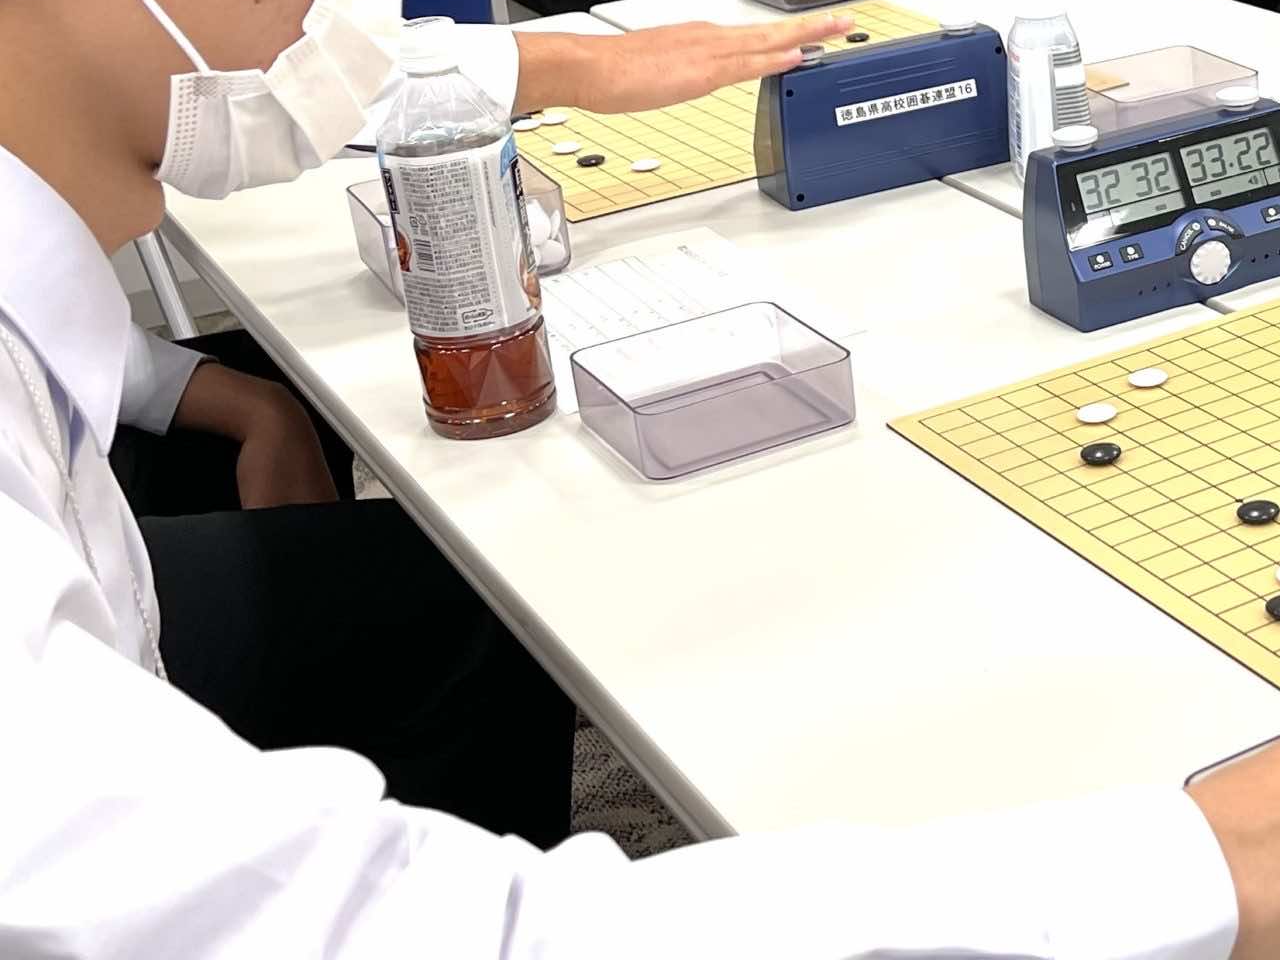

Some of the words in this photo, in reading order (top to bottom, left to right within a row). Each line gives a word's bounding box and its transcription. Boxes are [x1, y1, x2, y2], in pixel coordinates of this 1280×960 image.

[840, 82, 973, 122] 徳島県高校囲碁連盟16
